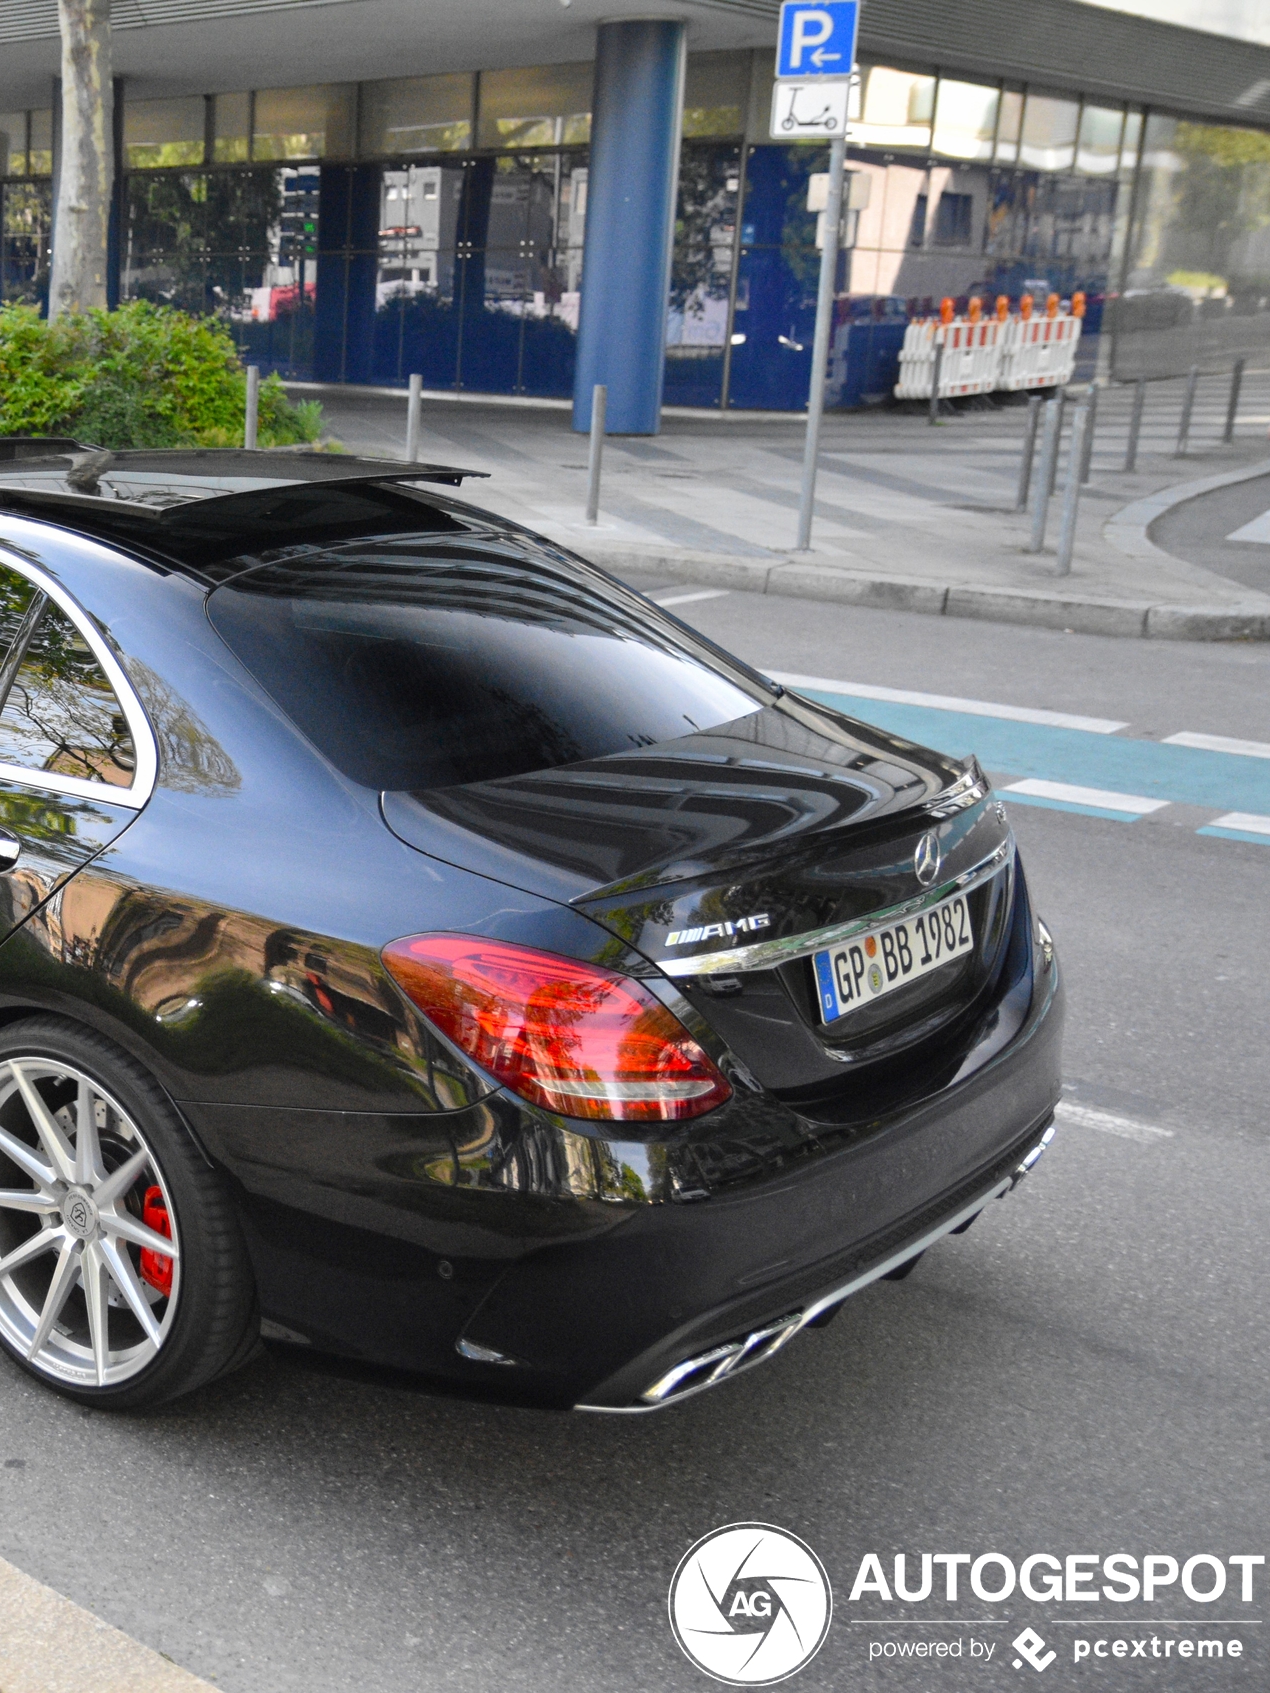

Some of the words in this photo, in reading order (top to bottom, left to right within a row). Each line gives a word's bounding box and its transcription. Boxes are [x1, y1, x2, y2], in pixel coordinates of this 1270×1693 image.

[790, 10, 834, 68] P
[701, 913, 770, 941] AMG
[834, 945, 864, 1004] GP
[880, 924, 913, 982] BB
[915, 898, 969, 966] 1982
[825, 993, 833, 1009] D
